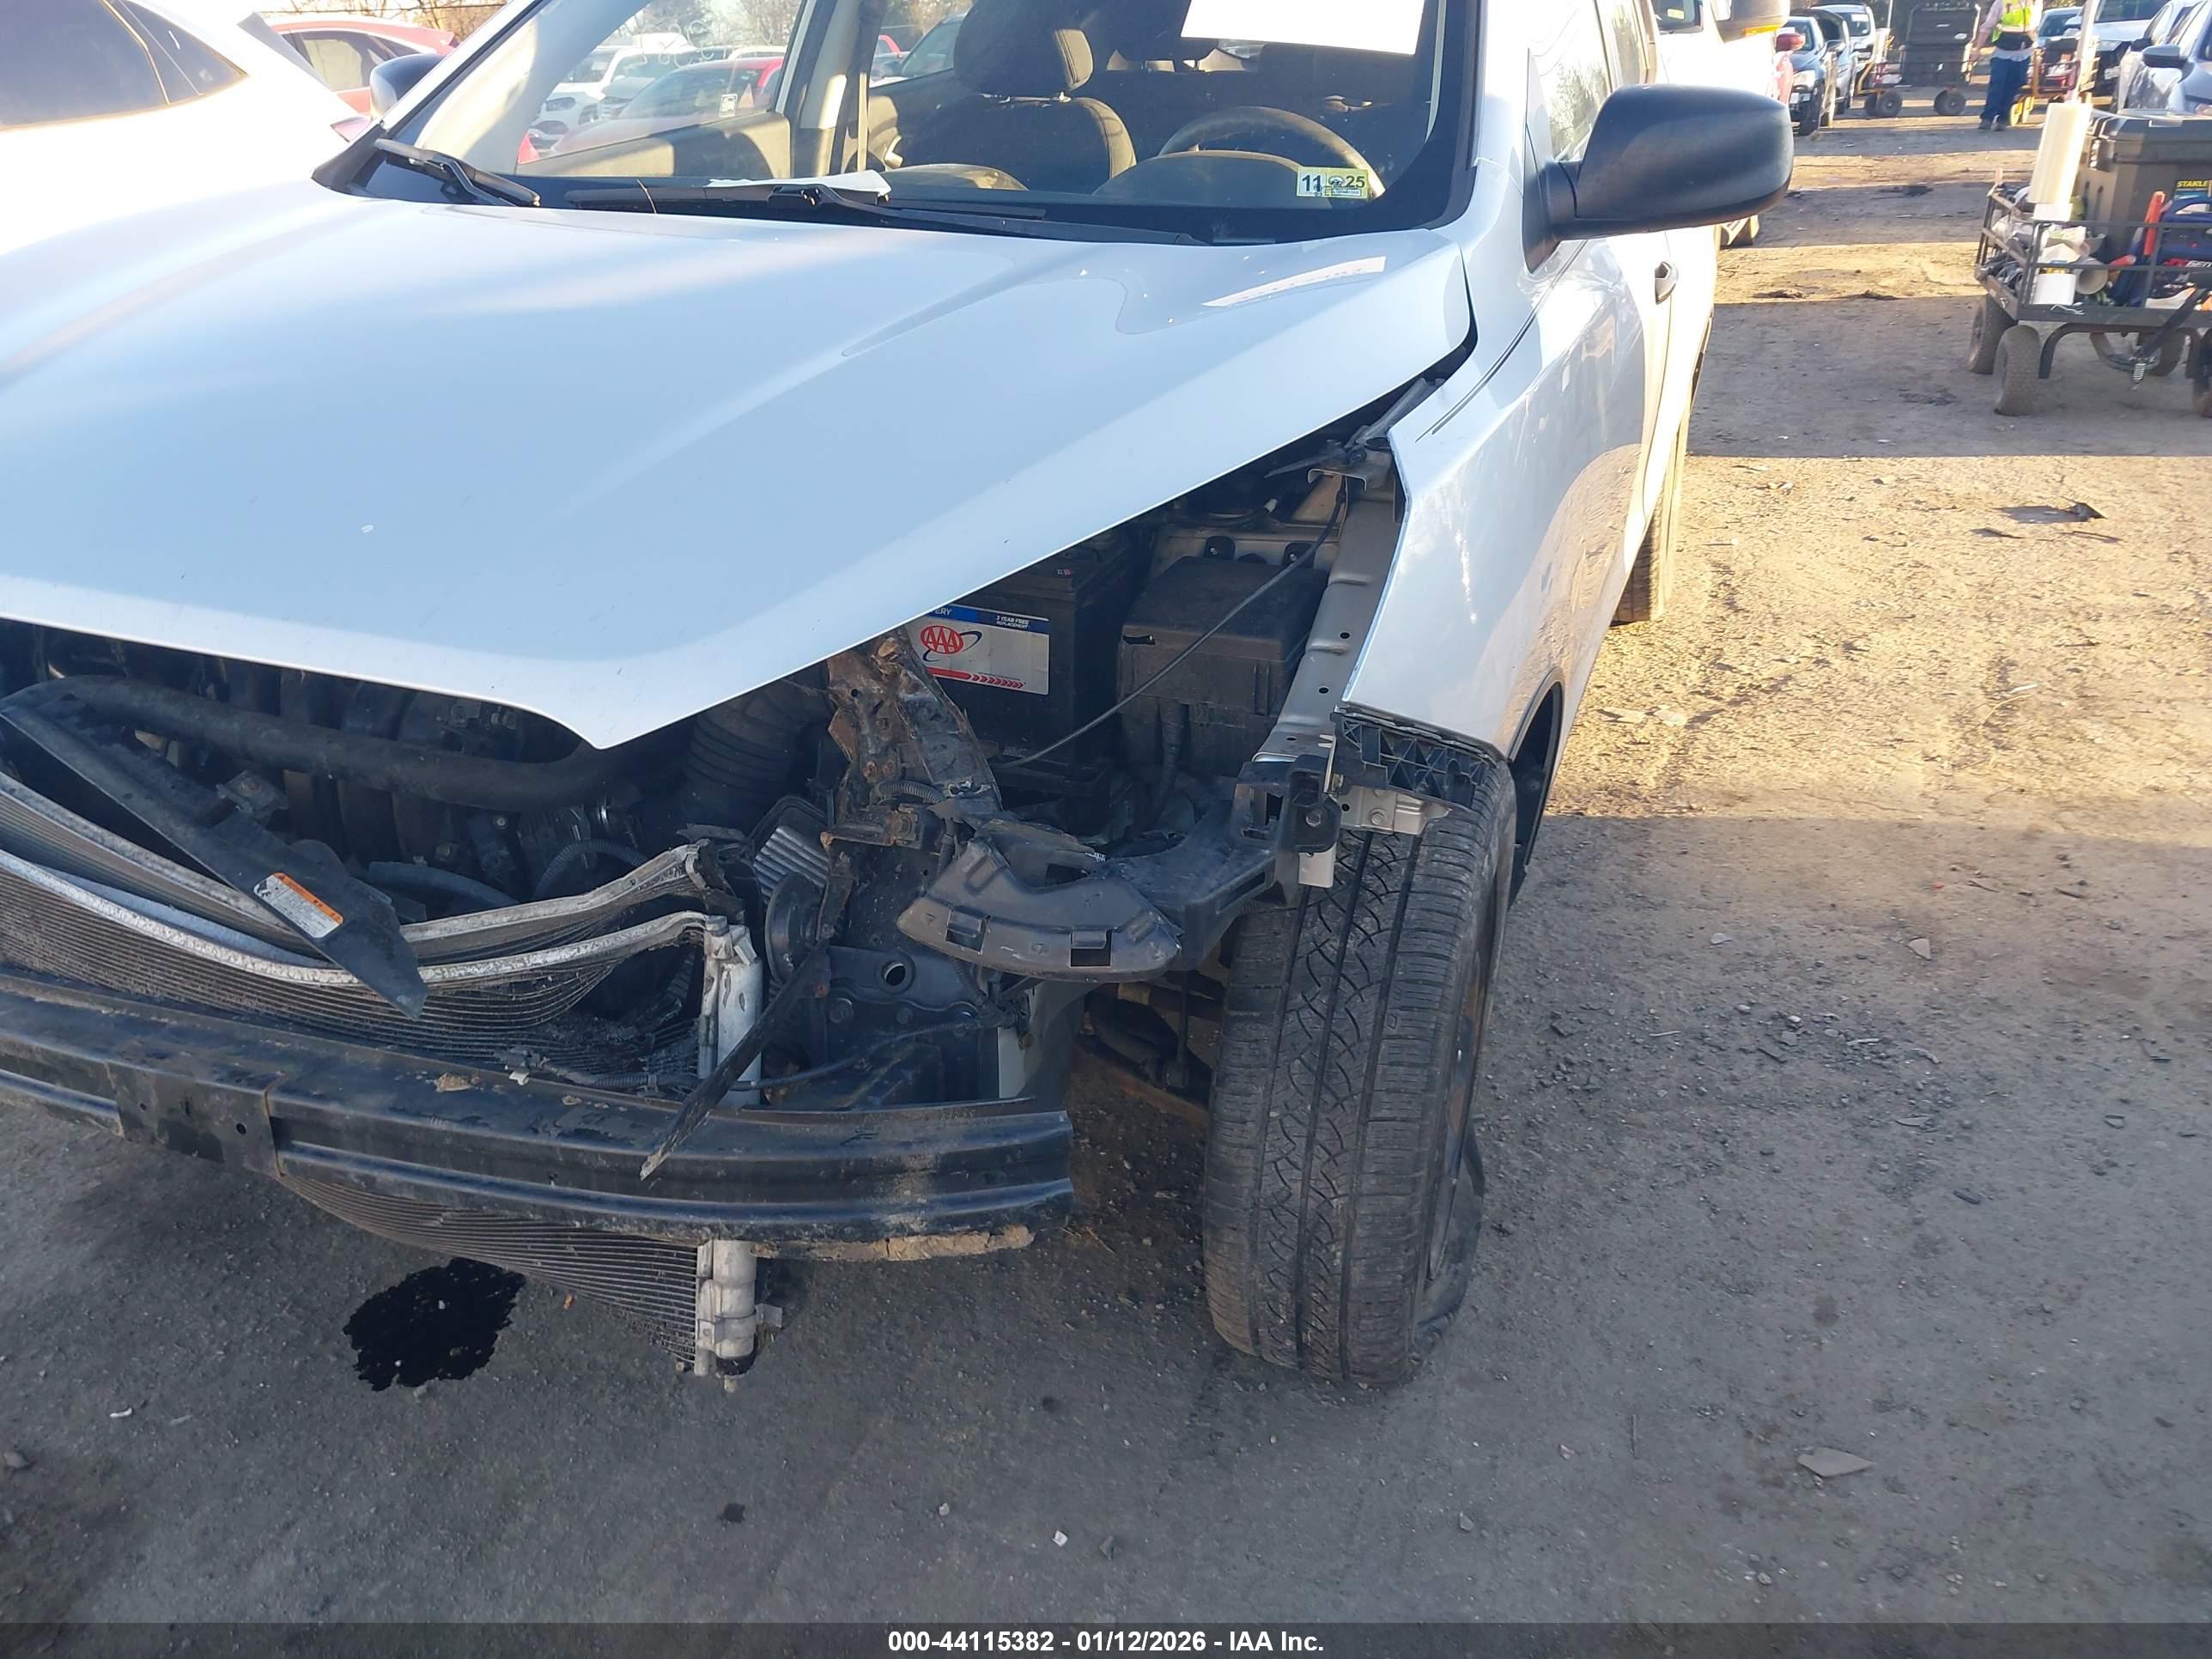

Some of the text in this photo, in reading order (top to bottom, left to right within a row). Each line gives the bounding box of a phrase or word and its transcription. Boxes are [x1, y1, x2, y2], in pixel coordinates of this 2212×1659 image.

[1302, 174, 1321, 192] 11
[1346, 175, 1365, 188] 25
[924, 626, 962, 653] AAA
